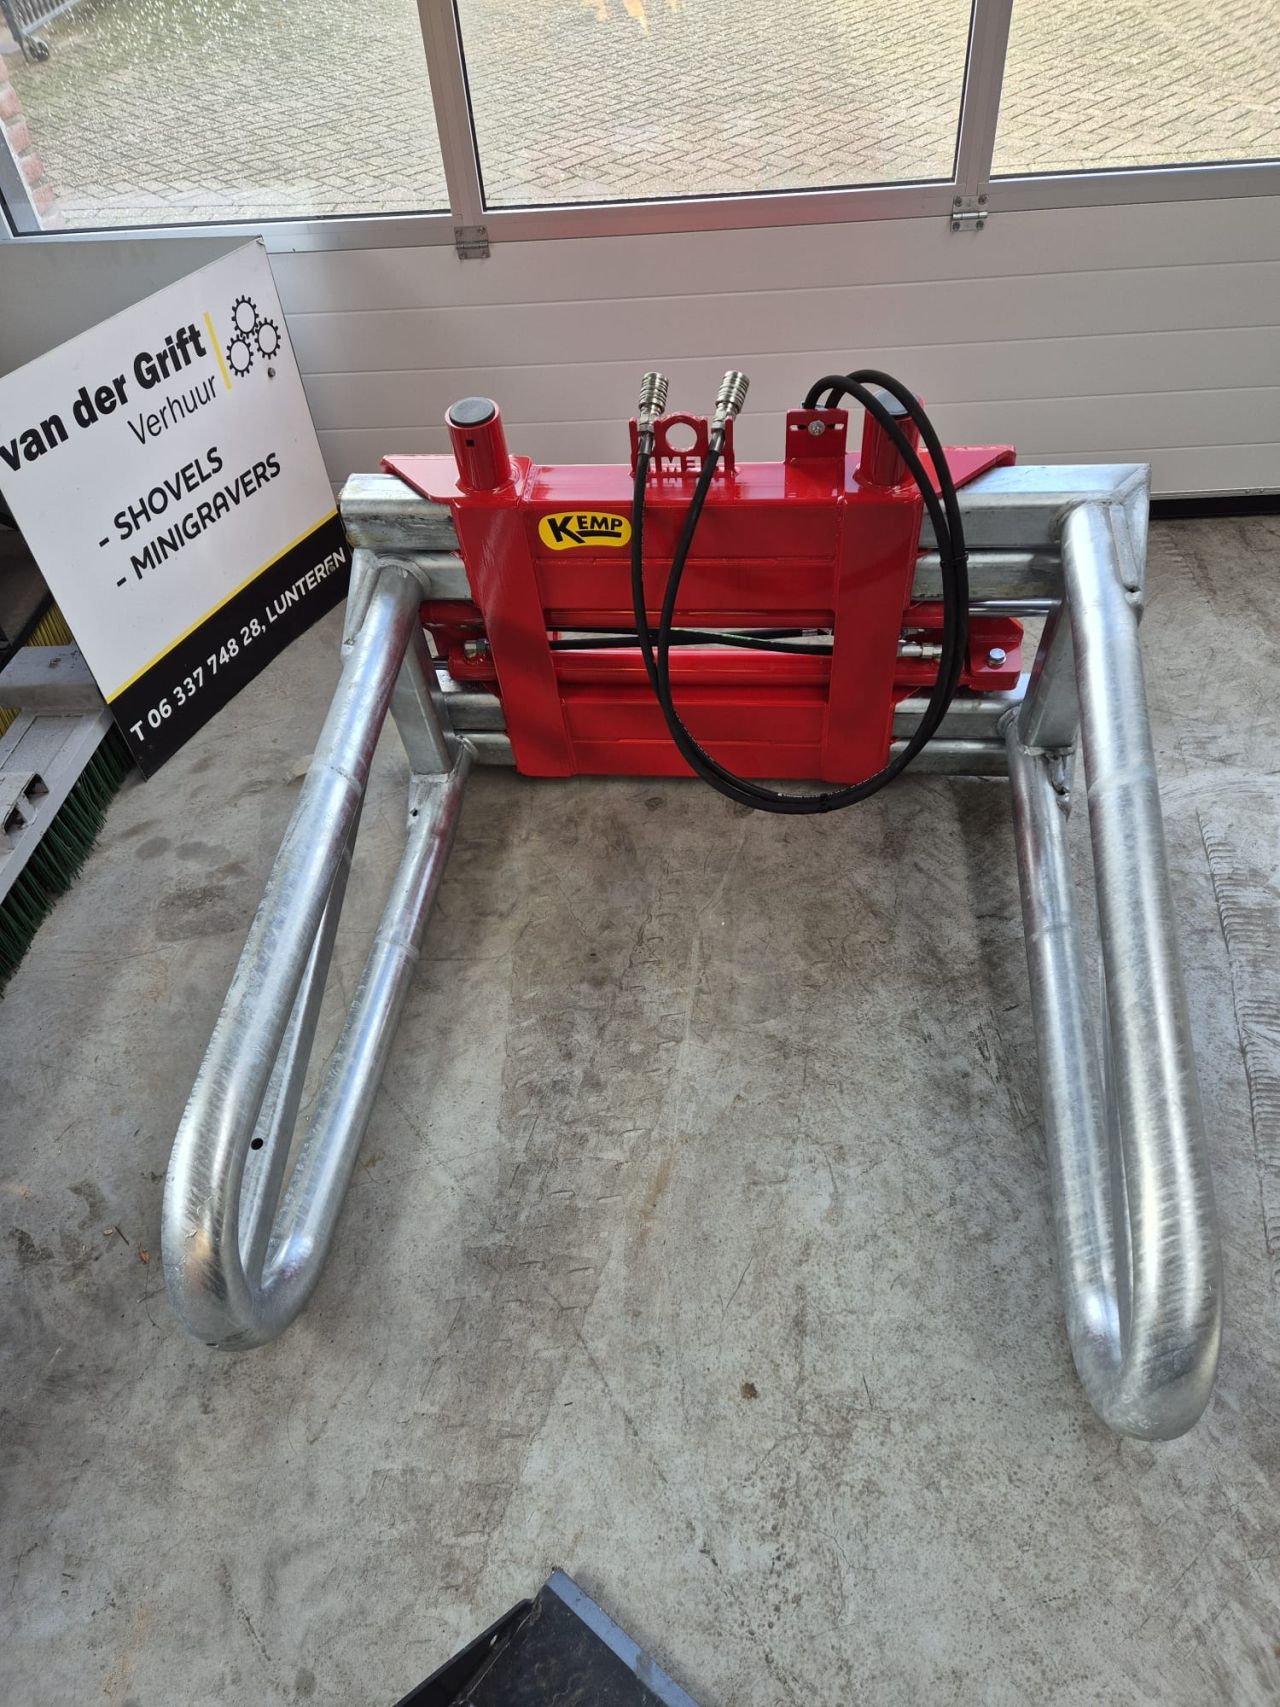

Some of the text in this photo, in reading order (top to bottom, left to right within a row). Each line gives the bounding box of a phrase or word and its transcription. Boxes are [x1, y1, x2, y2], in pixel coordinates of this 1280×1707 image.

[0, 323, 207, 471] van der Grift
[127, 375, 216, 445] Verhuur
[98, 446, 223, 547] - SHOVELS
[116, 452, 281, 587] - MINIGRAVERS
[547, 514, 623, 544] KEMP
[129, 547, 347, 742] T 06 337 748 28, LUNTEREN
